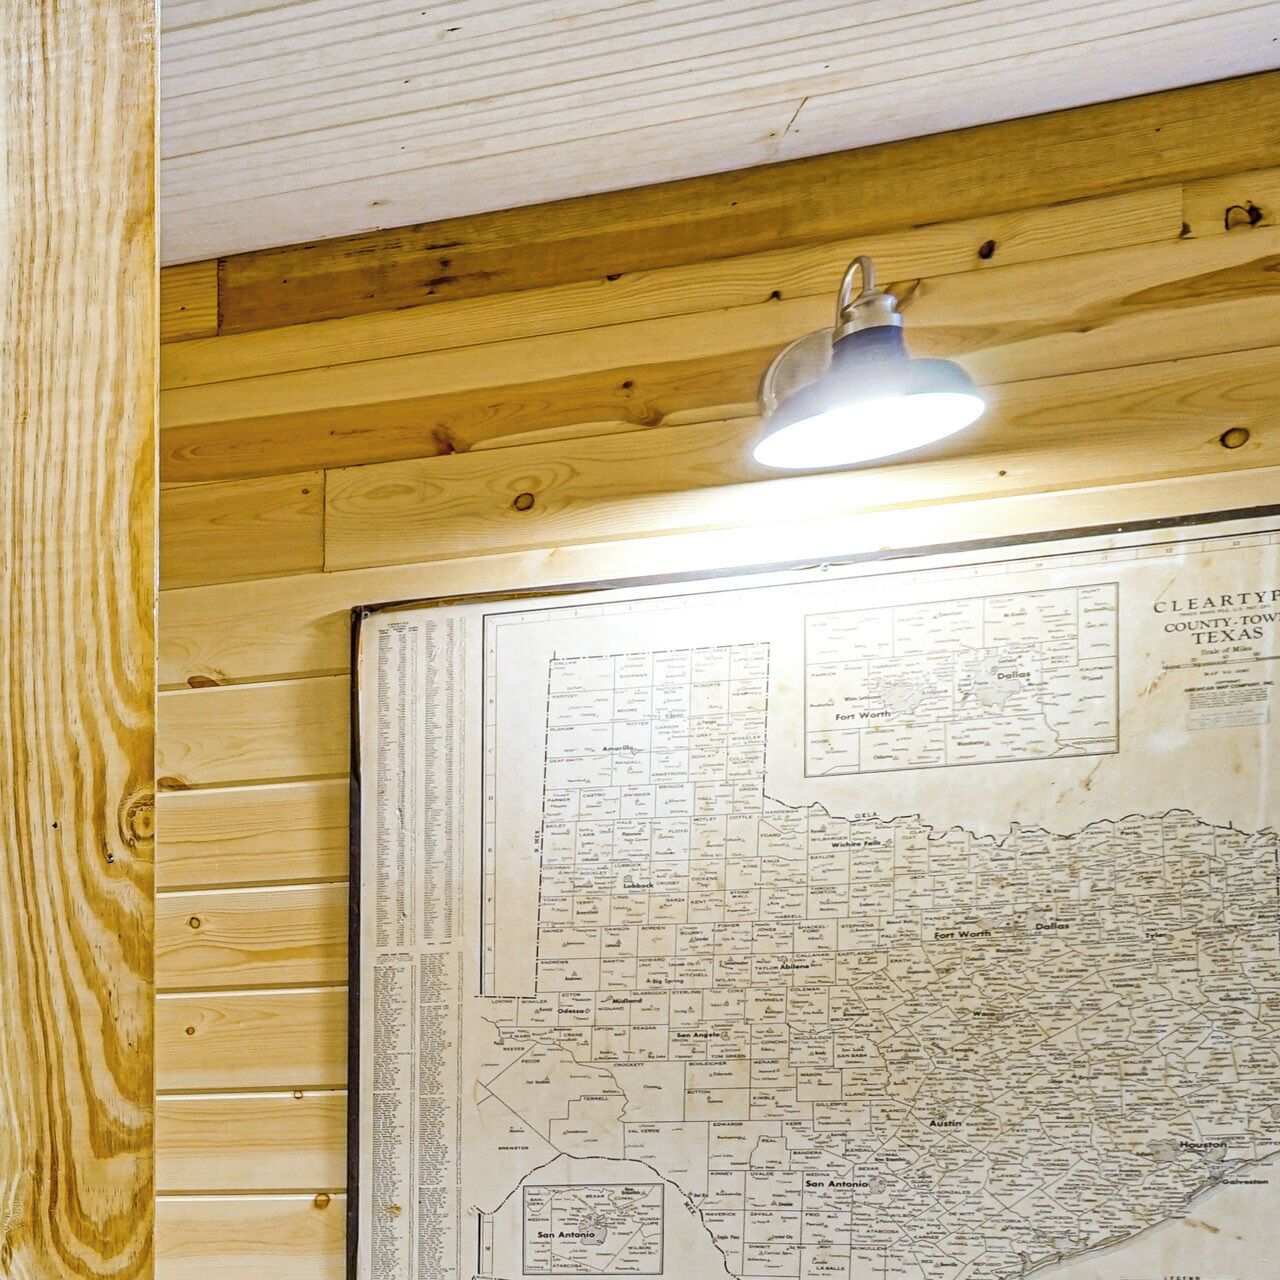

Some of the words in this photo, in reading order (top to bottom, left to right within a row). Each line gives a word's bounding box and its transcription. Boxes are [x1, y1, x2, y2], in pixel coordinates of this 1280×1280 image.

[1153, 589, 1280, 613] CLEARTYP
[1164, 612, 1280, 633] COUNTY-TOW
[1191, 627, 1263, 645] TEXAS
[997, 671, 1031, 680] Dallas
[835, 712, 856, 721] Fort
[859, 710, 891, 719] Worth
[1036, 923, 1070, 931] Dallas
[934, 931, 959, 940] Fort
[964, 930, 991, 938] Worth
[929, 1120, 962, 1128] Austin
[1180, 1141, 1227, 1149] Houston
[805, 1180, 825, 1188] San
[828, 1180, 869, 1188] Antonio
[1222, 1178, 1269, 1186] Galveston
[537, 1231, 557, 1239] San
[560, 1231, 595, 1239] Antonio
